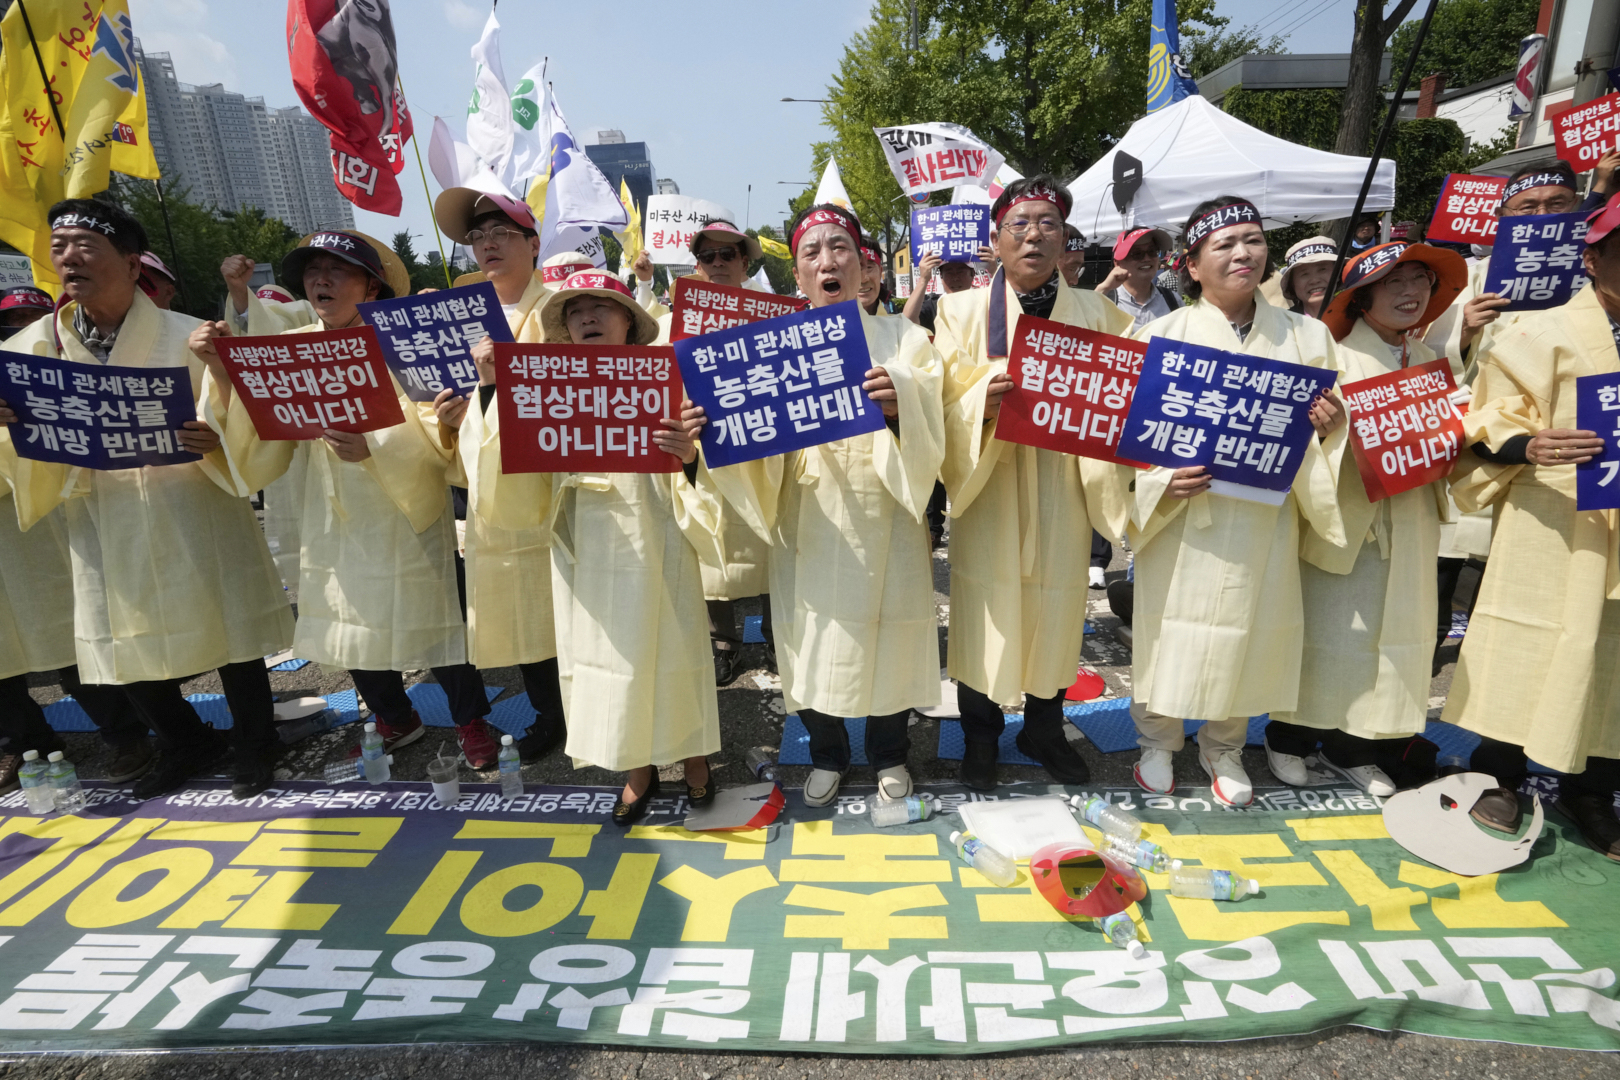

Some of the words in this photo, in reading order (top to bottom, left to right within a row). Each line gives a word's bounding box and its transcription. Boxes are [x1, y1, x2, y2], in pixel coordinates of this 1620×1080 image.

[1560, 101, 1612, 128] 식량안보
[1453, 180, 1498, 195] 식량안보
[650, 209, 683, 223] 미국산
[686, 211, 709, 224] 사과
[917, 211, 940, 225] 한·미
[942, 209, 984, 221] 관세협상
[921, 222, 979, 241] 농축산물
[1187, 206, 1255, 245] 생존권사수
[1511, 222, 1565, 244] 한·미
[1515, 243, 1586, 273] 농축
[684, 287, 739, 312] 식량안보
[1500, 277, 1562, 302] 개방
[371, 310, 411, 332] 한·미
[413, 294, 488, 327] 관세협상
[228, 346, 294, 368] 식량안보
[296, 337, 368, 364] 국민건강
[390, 321, 490, 363] 농축산물
[692, 338, 749, 373] 한·미
[754, 315, 847, 358] 관세협상
[1025, 329, 1093, 363] 식량안보
[5, 362, 64, 391] 한·미
[72, 372, 174, 397] 관세협상
[238, 361, 379, 399] 협상대상이
[399, 365, 444, 393] 개방
[508, 355, 588, 380] 식량안보
[595, 357, 671, 382] 국민건강
[713, 347, 845, 409] 농축산물
[1020, 356, 1138, 409] 협상대상
[1160, 351, 1217, 383] 한·미
[1222, 363, 1318, 403] 관세협상
[25, 390, 168, 429] 농축산물
[511, 384, 670, 419] 협상대상이
[1347, 383, 1400, 414] 식량안보
[1398, 369, 1449, 400] 국민건강
[273, 397, 369, 429] 아니다!
[712, 406, 778, 447] 개방
[786, 385, 865, 433] 반대!
[1160, 382, 1293, 438] 농축산물
[24, 422, 90, 456] 개방
[100, 429, 186, 459] 반대!
[537, 425, 649, 457] 아니다!
[1137, 418, 1207, 459] 개방
[1212, 434, 1291, 474] 반대!
[1381, 431, 1458, 477] 아니다!
[0, 934, 496, 1031] 농축산물
[492, 943, 755, 1043] 협상
